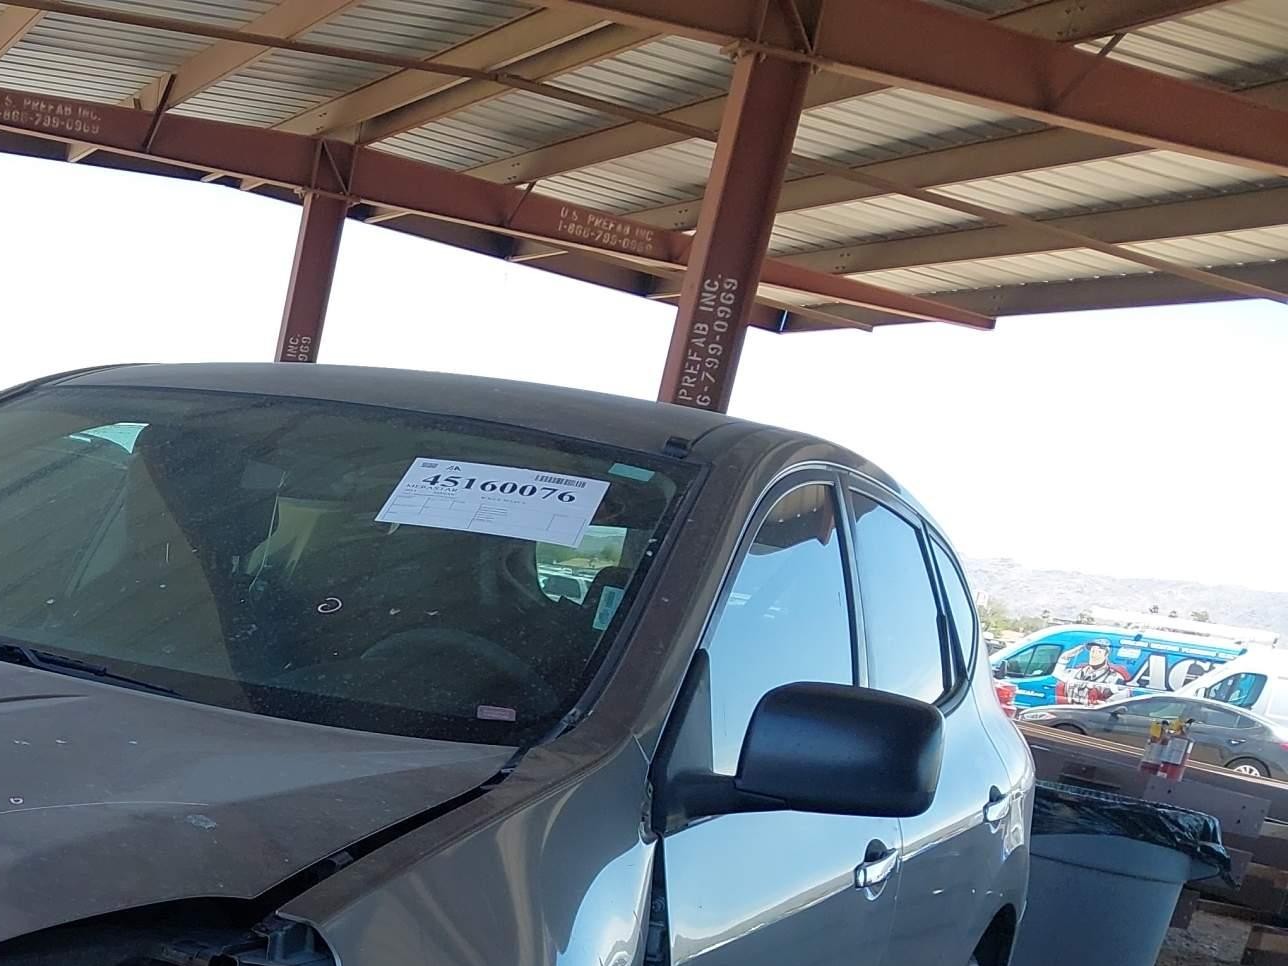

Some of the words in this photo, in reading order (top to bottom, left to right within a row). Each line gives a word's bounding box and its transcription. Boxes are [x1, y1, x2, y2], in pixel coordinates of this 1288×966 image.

[23, 98, 72, 116] PREFAB
[586, 213, 631, 234] PREFAB
[285, 333, 301, 358] INC.
[677, 322, 709, 401] PREFAB
[698, 273, 722, 312] INC.
[421, 473, 577, 503] 45160076
